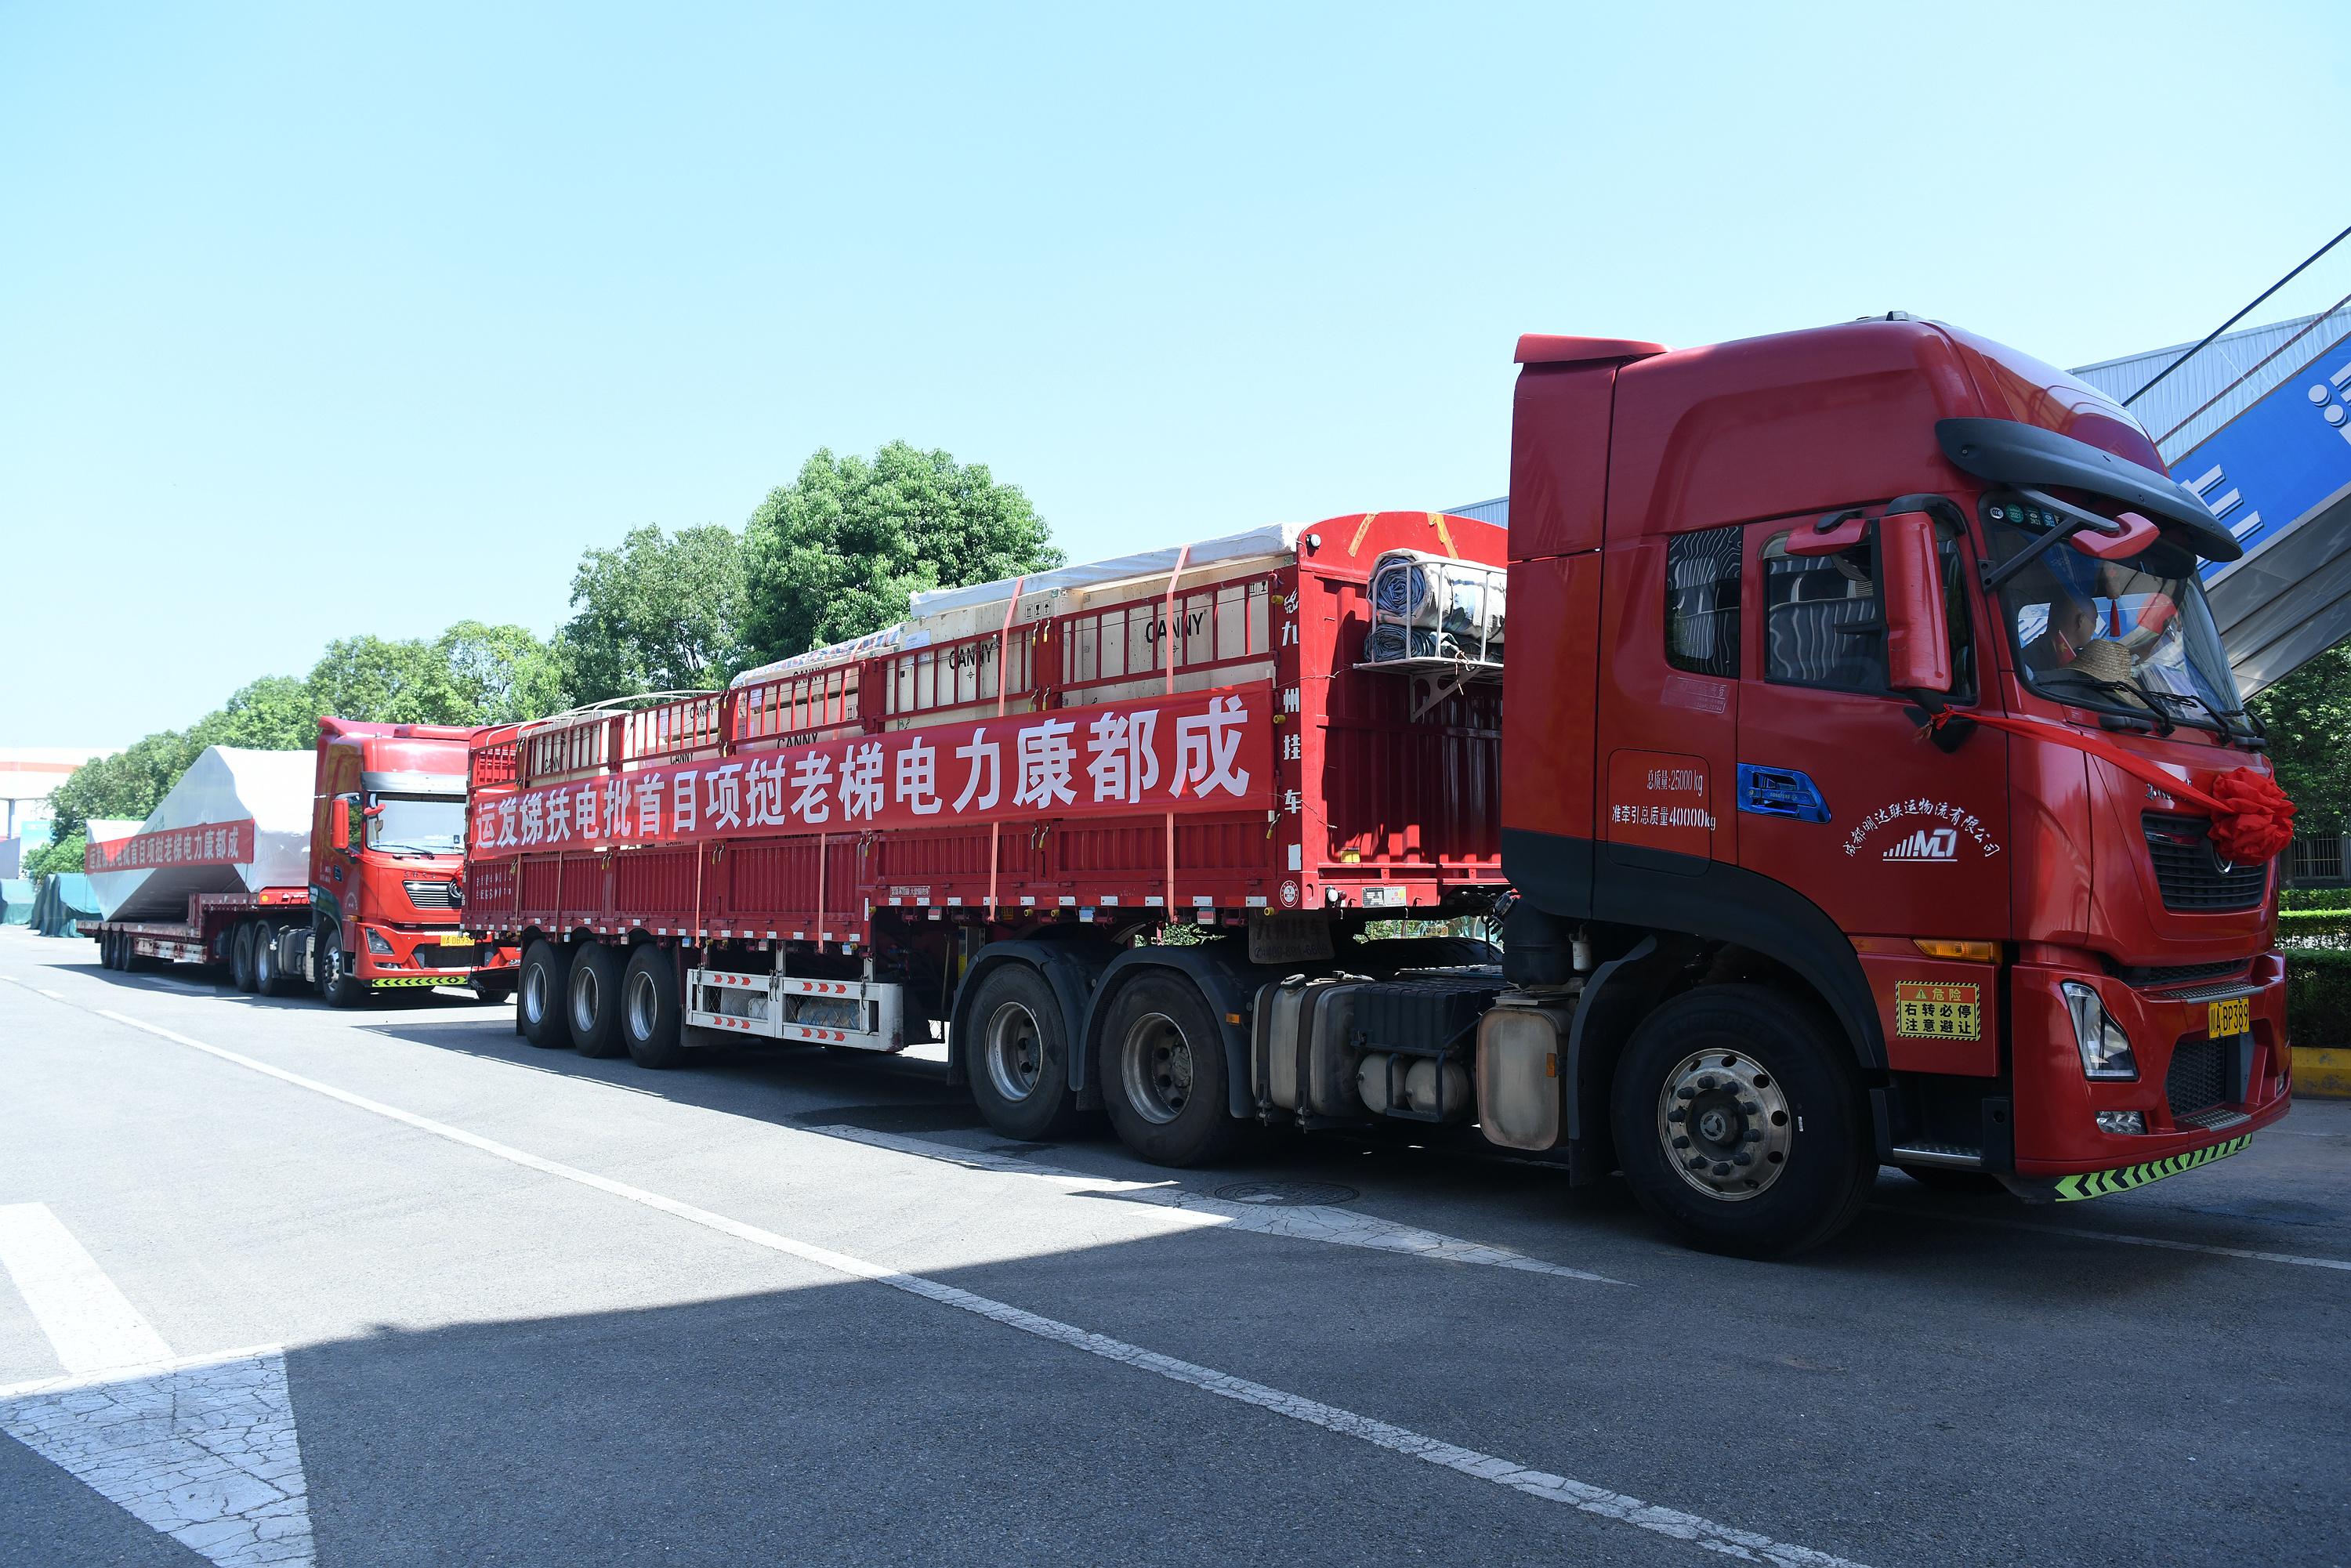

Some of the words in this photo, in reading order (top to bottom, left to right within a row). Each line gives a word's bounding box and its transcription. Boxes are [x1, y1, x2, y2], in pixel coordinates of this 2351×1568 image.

[690, 704, 715, 719] CANY
[1281, 620, 1302, 815] 九州挂车
[545, 755, 563, 772] CANN
[1611, 804, 1716, 831] 准牵引总质量40000kg
[1842, 797, 2001, 857] 成都明达联运物流有限公司
[1932, 987, 1962, 1001] 危险
[1904, 1002, 1972, 1019] 右转必停
[1905, 1018, 1972, 1034] 注意避让
